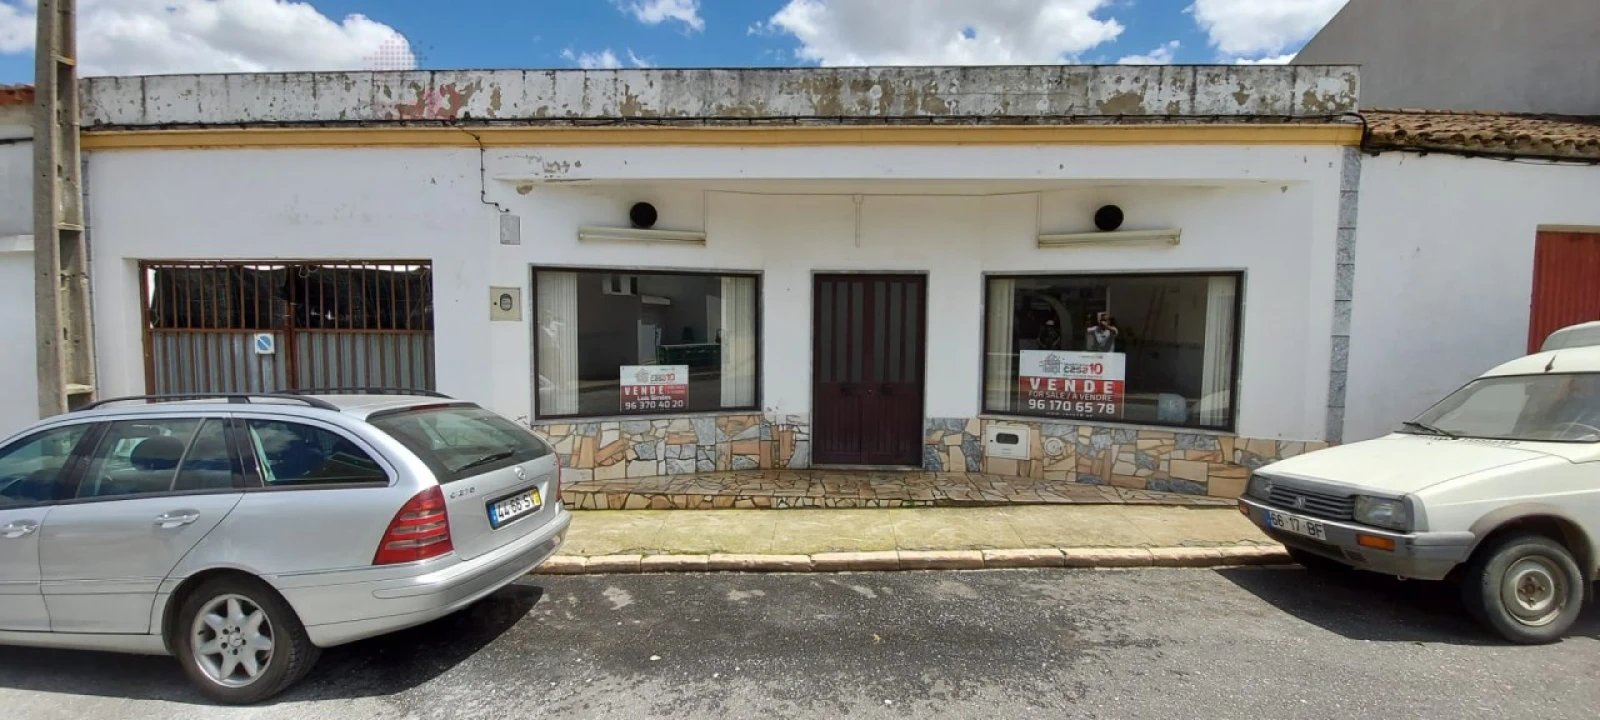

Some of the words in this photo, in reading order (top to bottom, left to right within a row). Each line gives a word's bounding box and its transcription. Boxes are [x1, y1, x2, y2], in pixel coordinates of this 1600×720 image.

[625, 385, 664, 395] VENDE
[1029, 377, 1113, 394] VENDE
[1028, 390, 1044, 398] FOR
[1046, 391, 1065, 399] SALE
[1079, 393, 1112, 402] VENDRE
[625, 402, 637, 410] 96
[639, 401, 656, 409] 370
[658, 400, 671, 408] 40
[672, 399, 684, 408] 20
[1028, 399, 1045, 410] 96
[1049, 400, 1071, 411] 170
[1075, 402, 1094, 413] 65
[1096, 403, 1115, 415] 78
